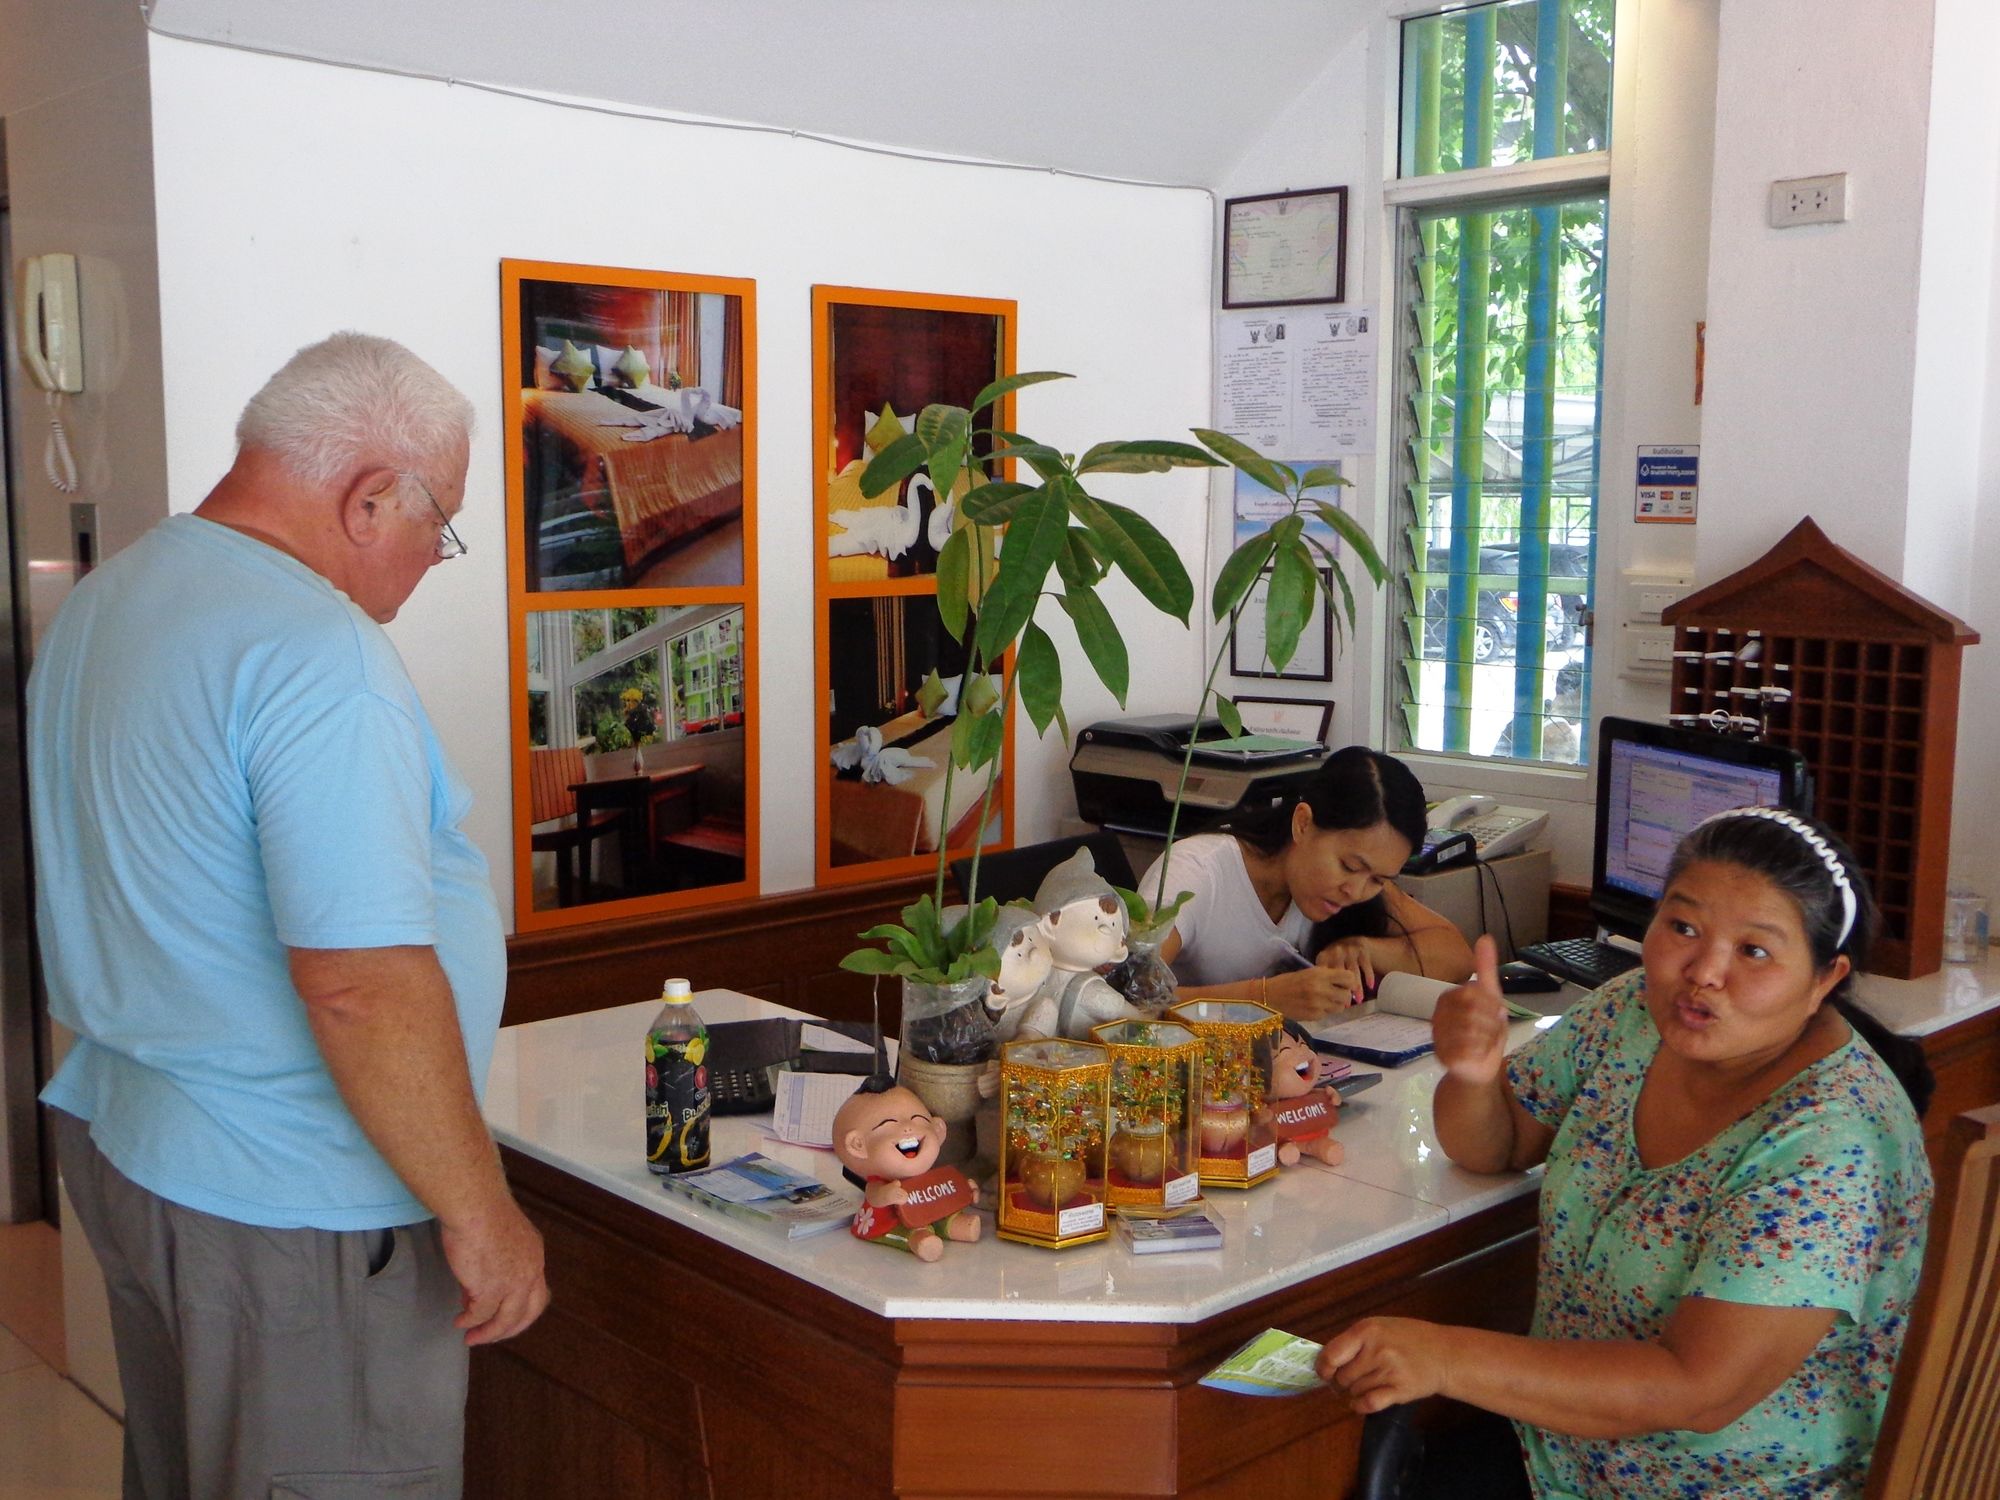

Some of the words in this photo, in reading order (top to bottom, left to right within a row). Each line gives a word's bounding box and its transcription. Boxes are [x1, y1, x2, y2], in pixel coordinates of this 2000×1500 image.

[1640, 491, 1656, 499] VISA
[1274, 1102, 1328, 1125] WELCOME
[907, 1180, 957, 1205] WELCOME
